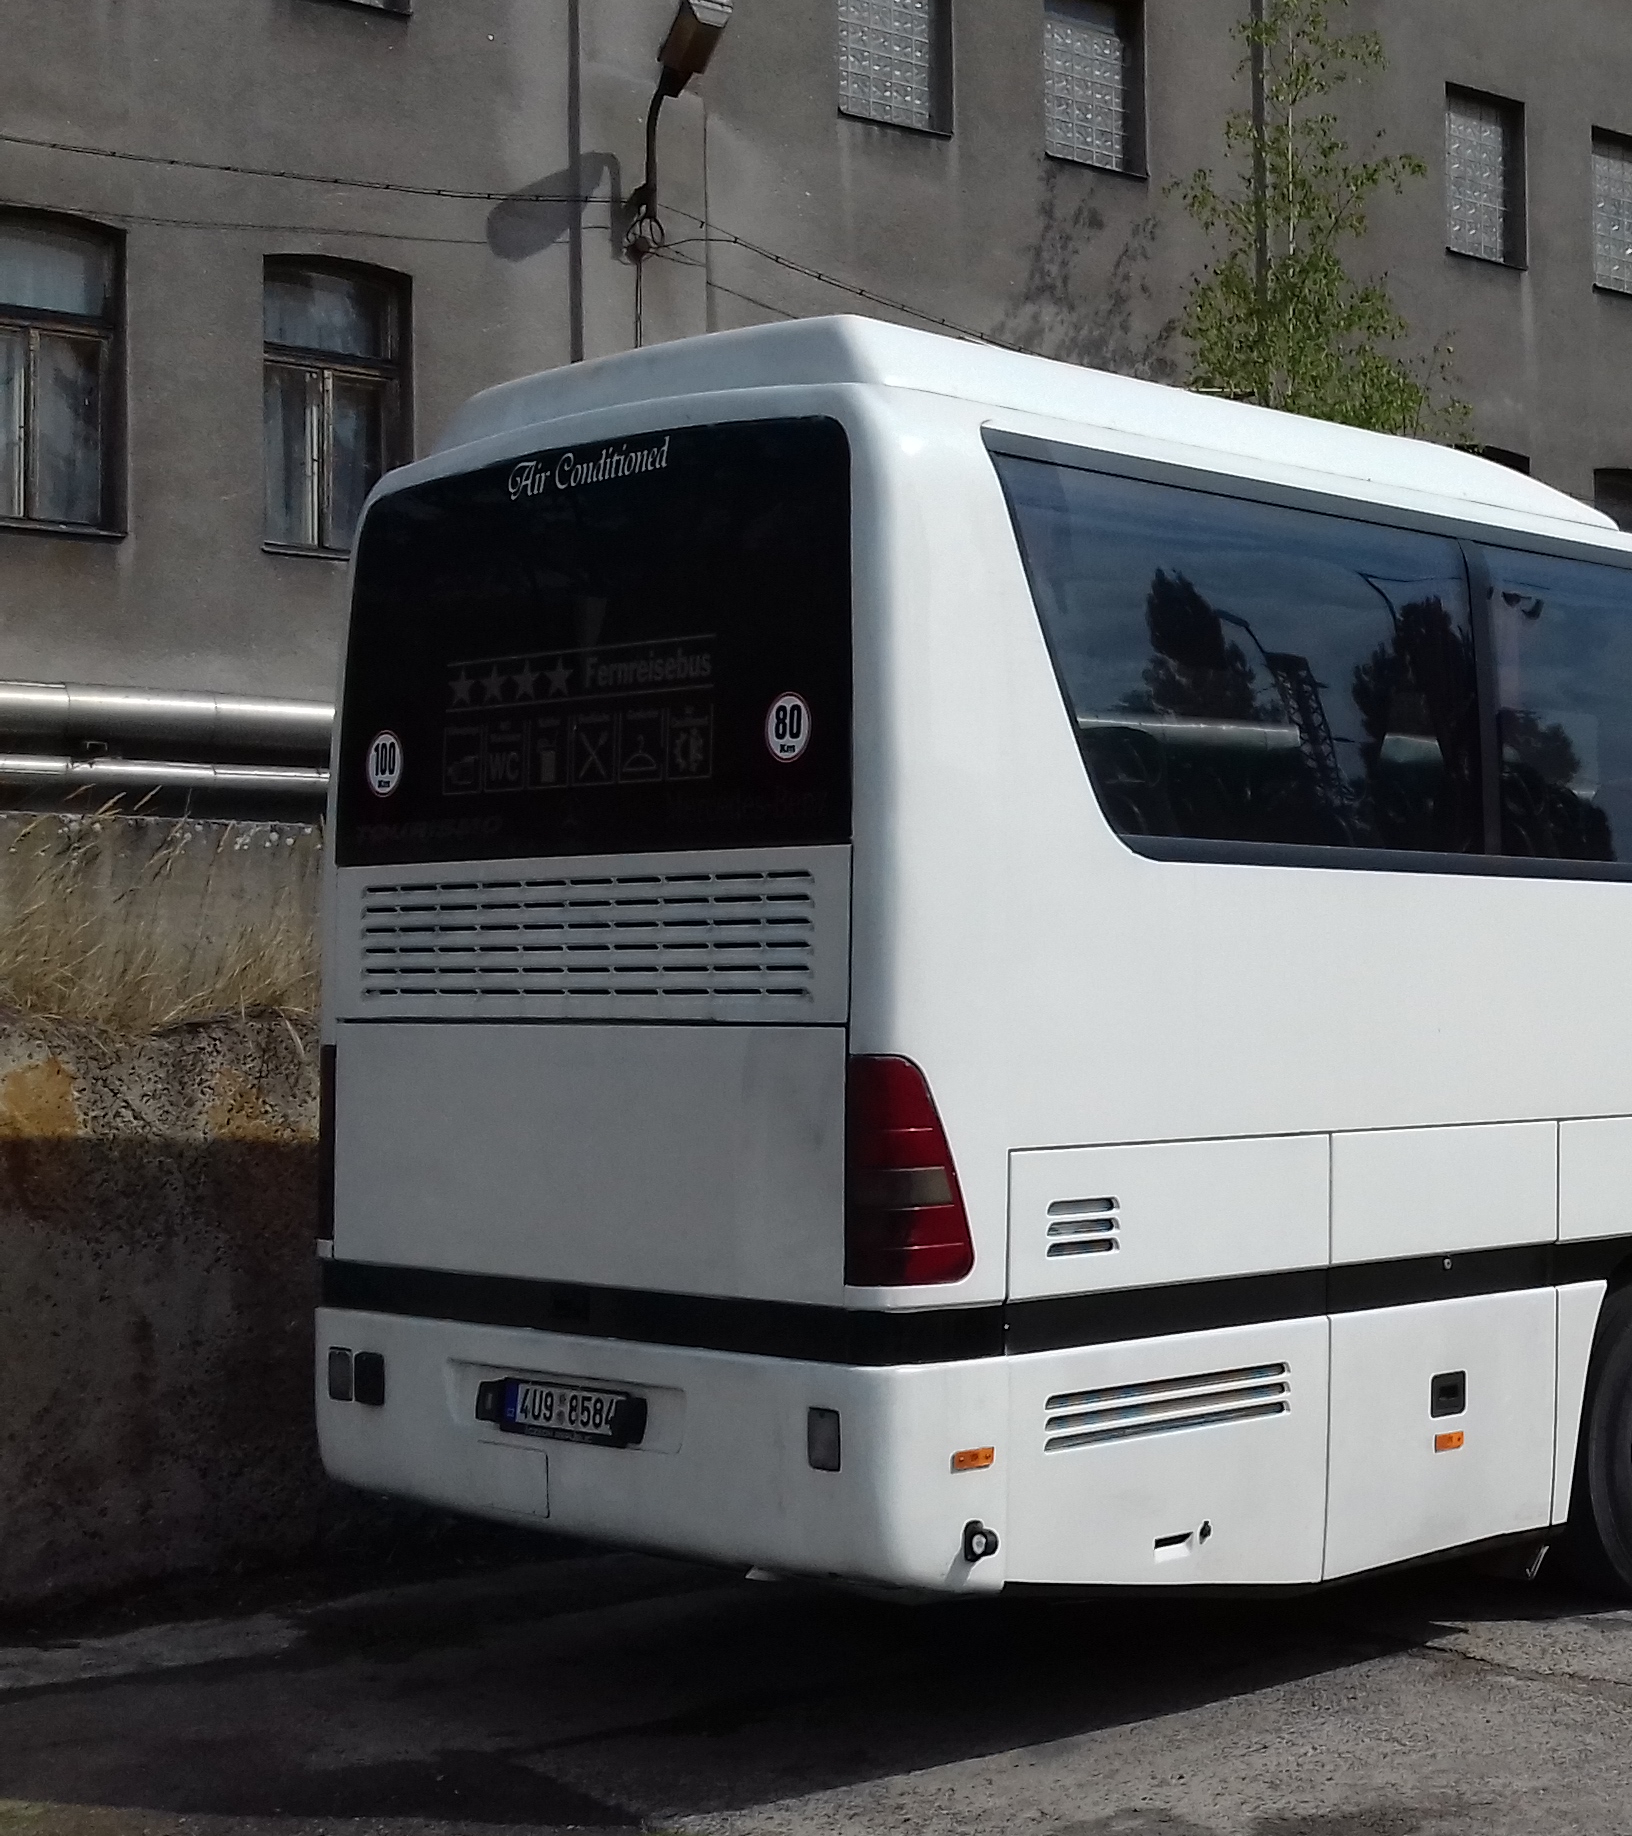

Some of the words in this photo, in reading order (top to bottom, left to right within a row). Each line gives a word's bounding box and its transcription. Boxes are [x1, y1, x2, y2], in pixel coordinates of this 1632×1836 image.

[508, 460, 550, 500] Air
[555, 435, 670, 489] Conditioned
[584, 647, 712, 689] Fernreisebus
[775, 703, 802, 740] 80
[374, 741, 396, 777] 100
[487, 749, 519, 782] WC
[519, 1387, 554, 1423] 4U9
